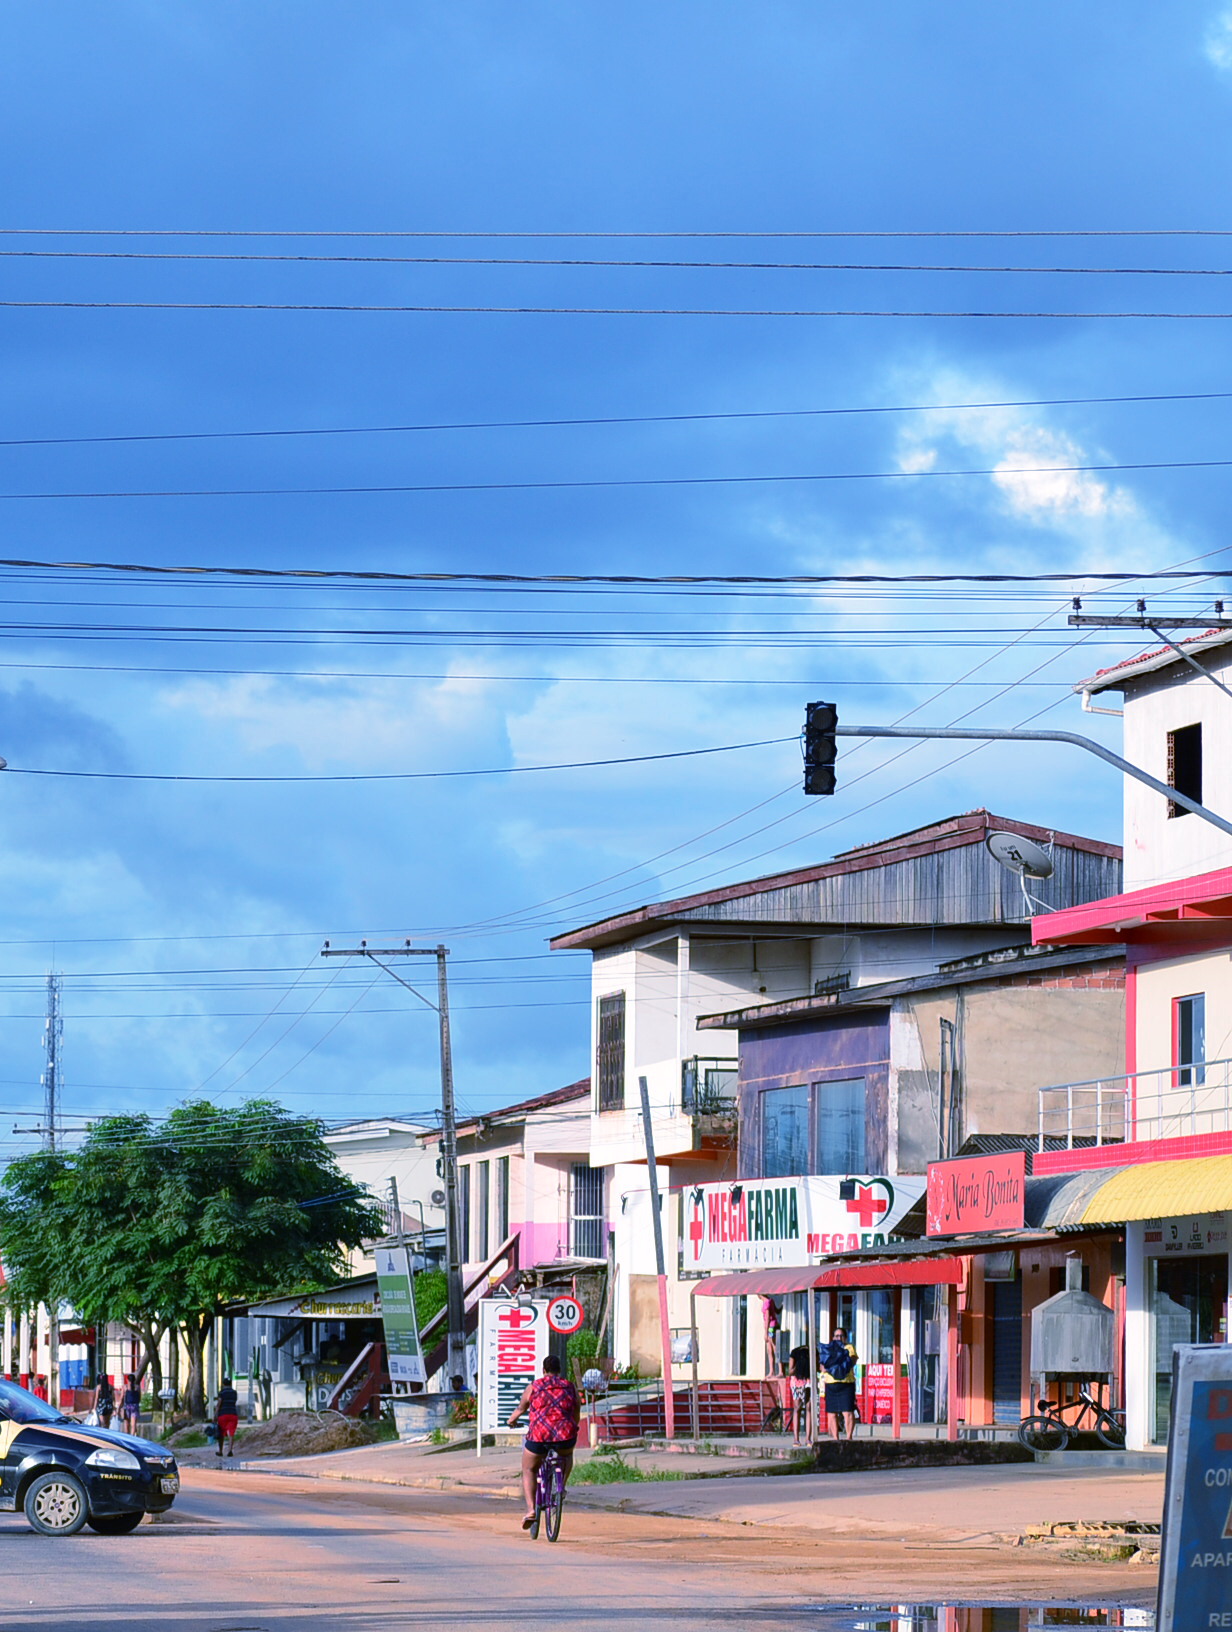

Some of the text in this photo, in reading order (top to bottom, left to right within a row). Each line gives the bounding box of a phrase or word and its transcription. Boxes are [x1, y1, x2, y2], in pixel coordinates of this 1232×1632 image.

[1007, 850, 1023, 861] 21
[946, 1168, 1019, 1221] Maria Bonita
[708, 1187, 799, 1243] MEGAFARMA
[721, 1243, 784, 1263] FARMÁCIA
[555, 1305, 576, 1320] 30
[868, 1365, 883, 1376] AQUI
